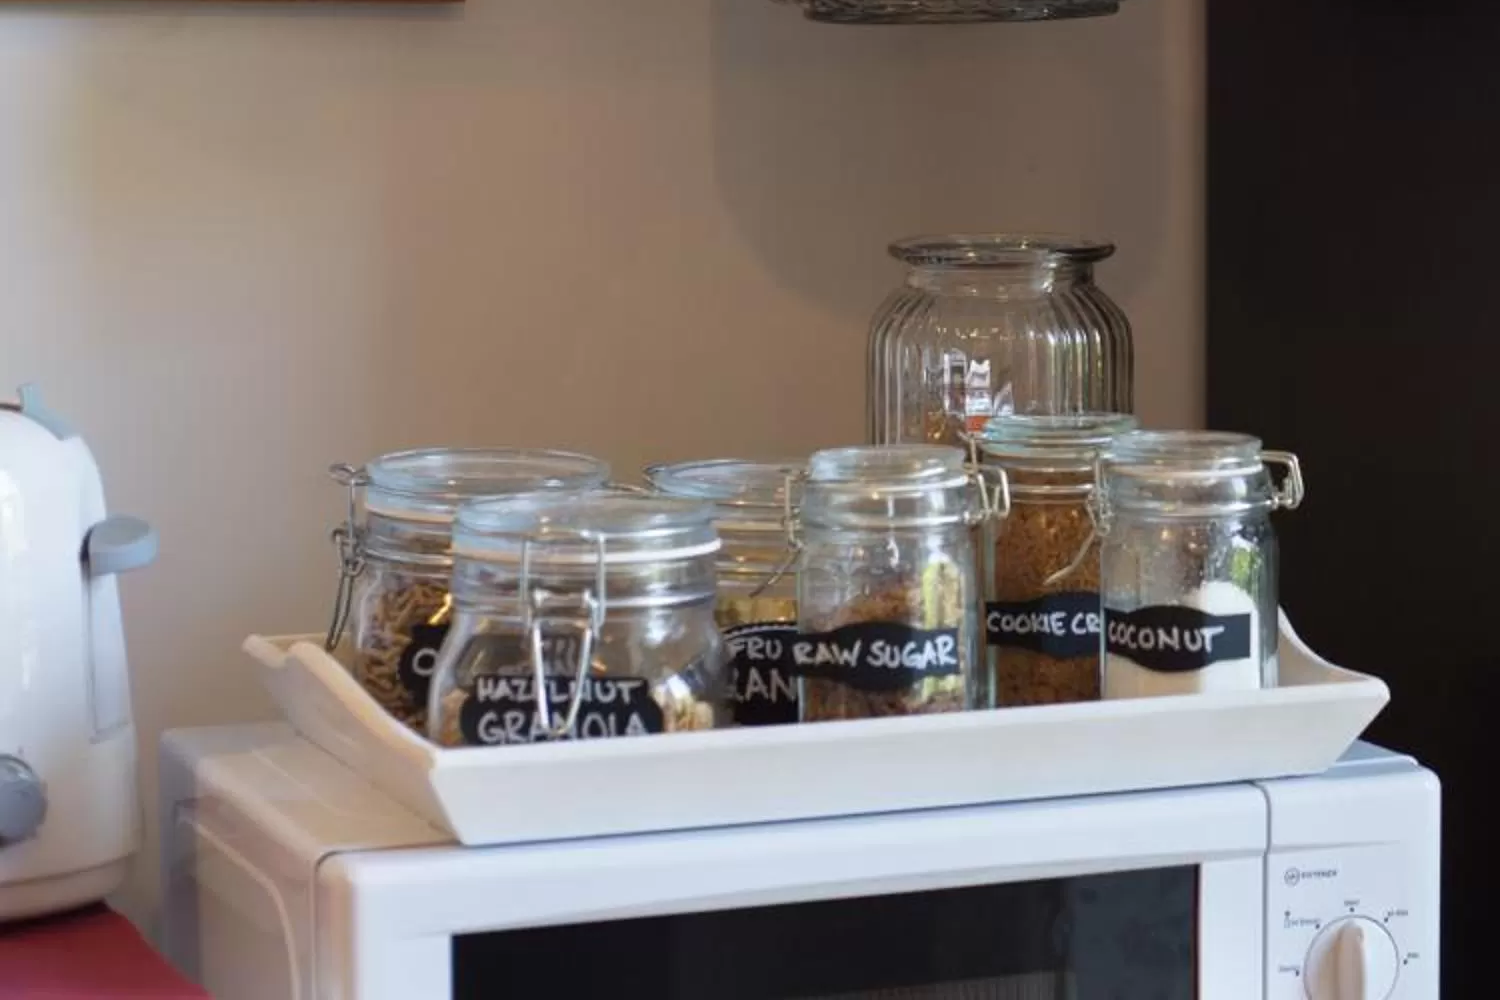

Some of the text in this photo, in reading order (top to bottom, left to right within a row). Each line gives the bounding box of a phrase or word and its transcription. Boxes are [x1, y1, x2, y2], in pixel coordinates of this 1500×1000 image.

[986, 611, 1068, 637] COOKIE
[1107, 619, 1226, 653] COCONUT
[792, 633, 958, 669] RAW SUGAR
